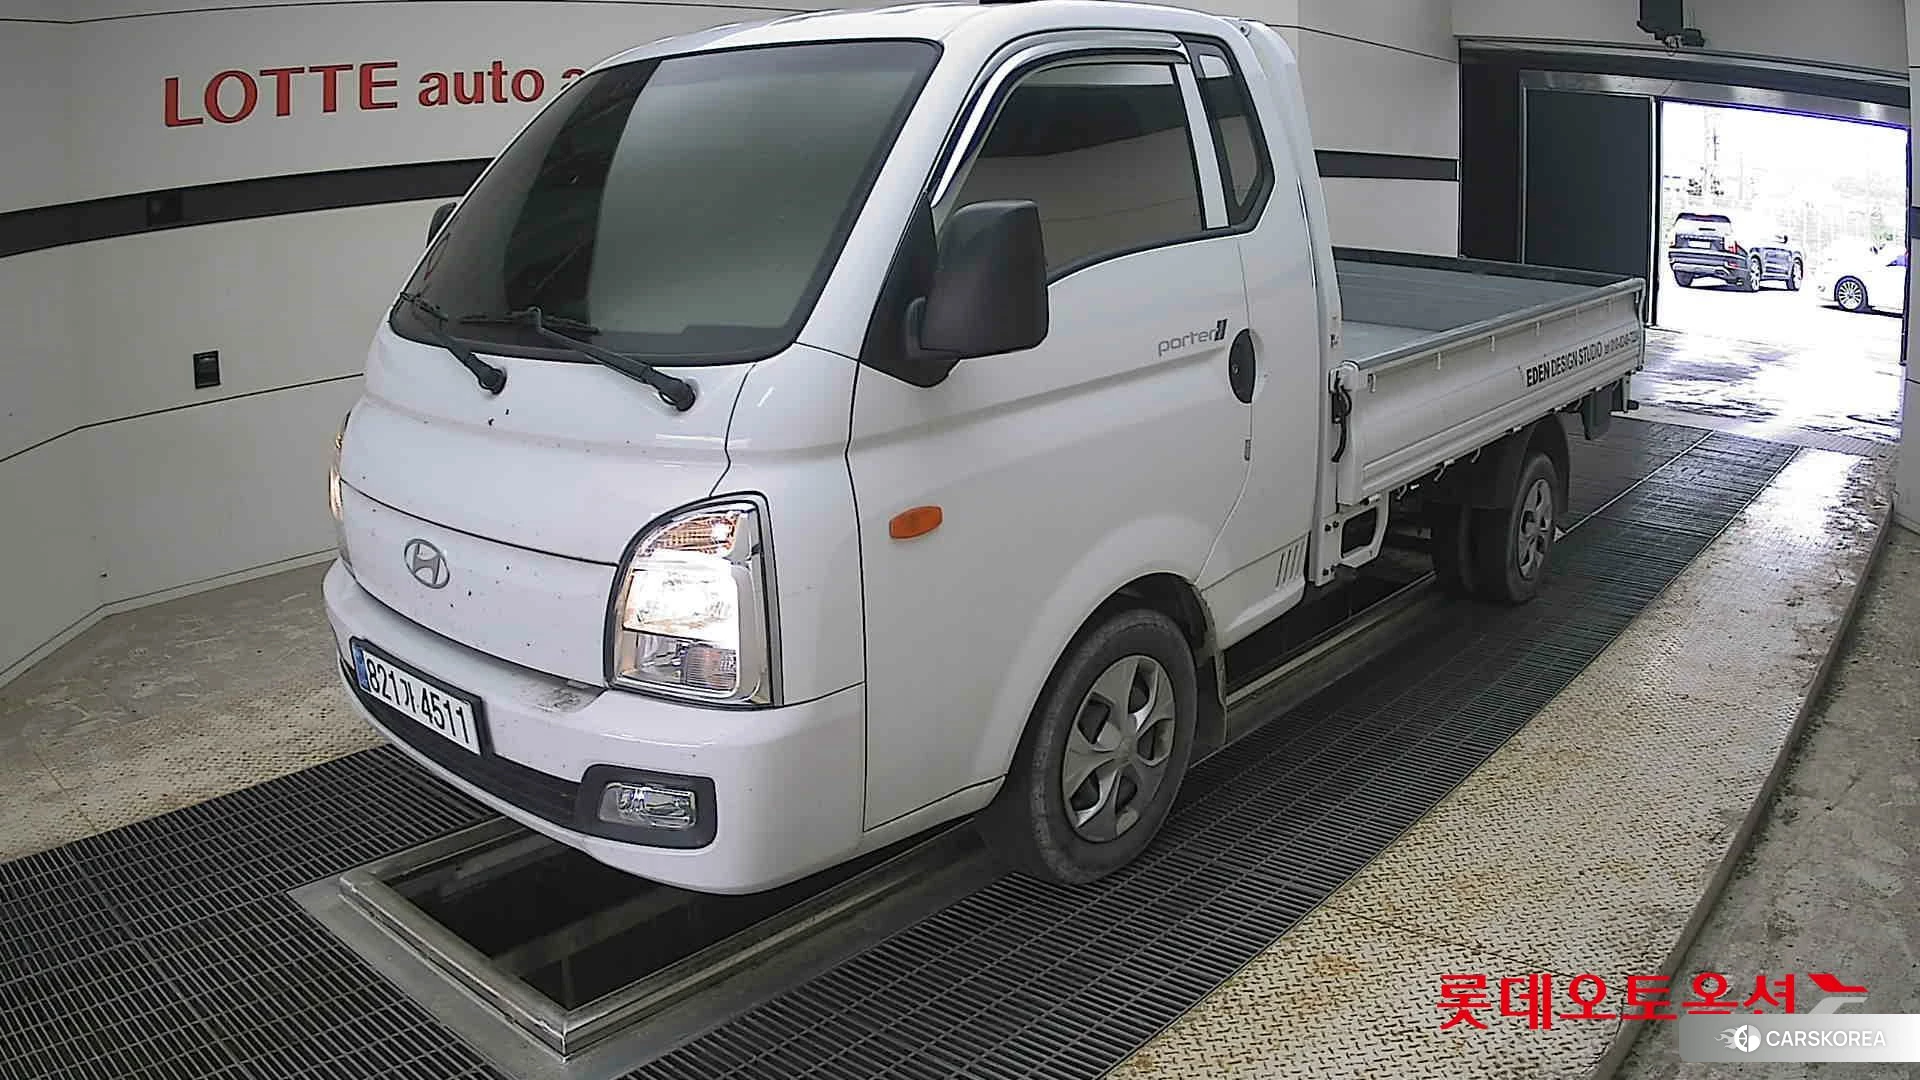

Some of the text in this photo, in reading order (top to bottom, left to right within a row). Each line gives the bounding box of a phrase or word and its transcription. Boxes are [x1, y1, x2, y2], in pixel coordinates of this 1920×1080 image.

[164, 61, 399, 127] LOTTE
[418, 60, 545, 107] auto
[1158, 328, 1217, 357] porter
[1525, 360, 1550, 387] EDEN
[1551, 350, 1578, 378] DESIGN
[1578, 341, 1603, 366] STUDIO
